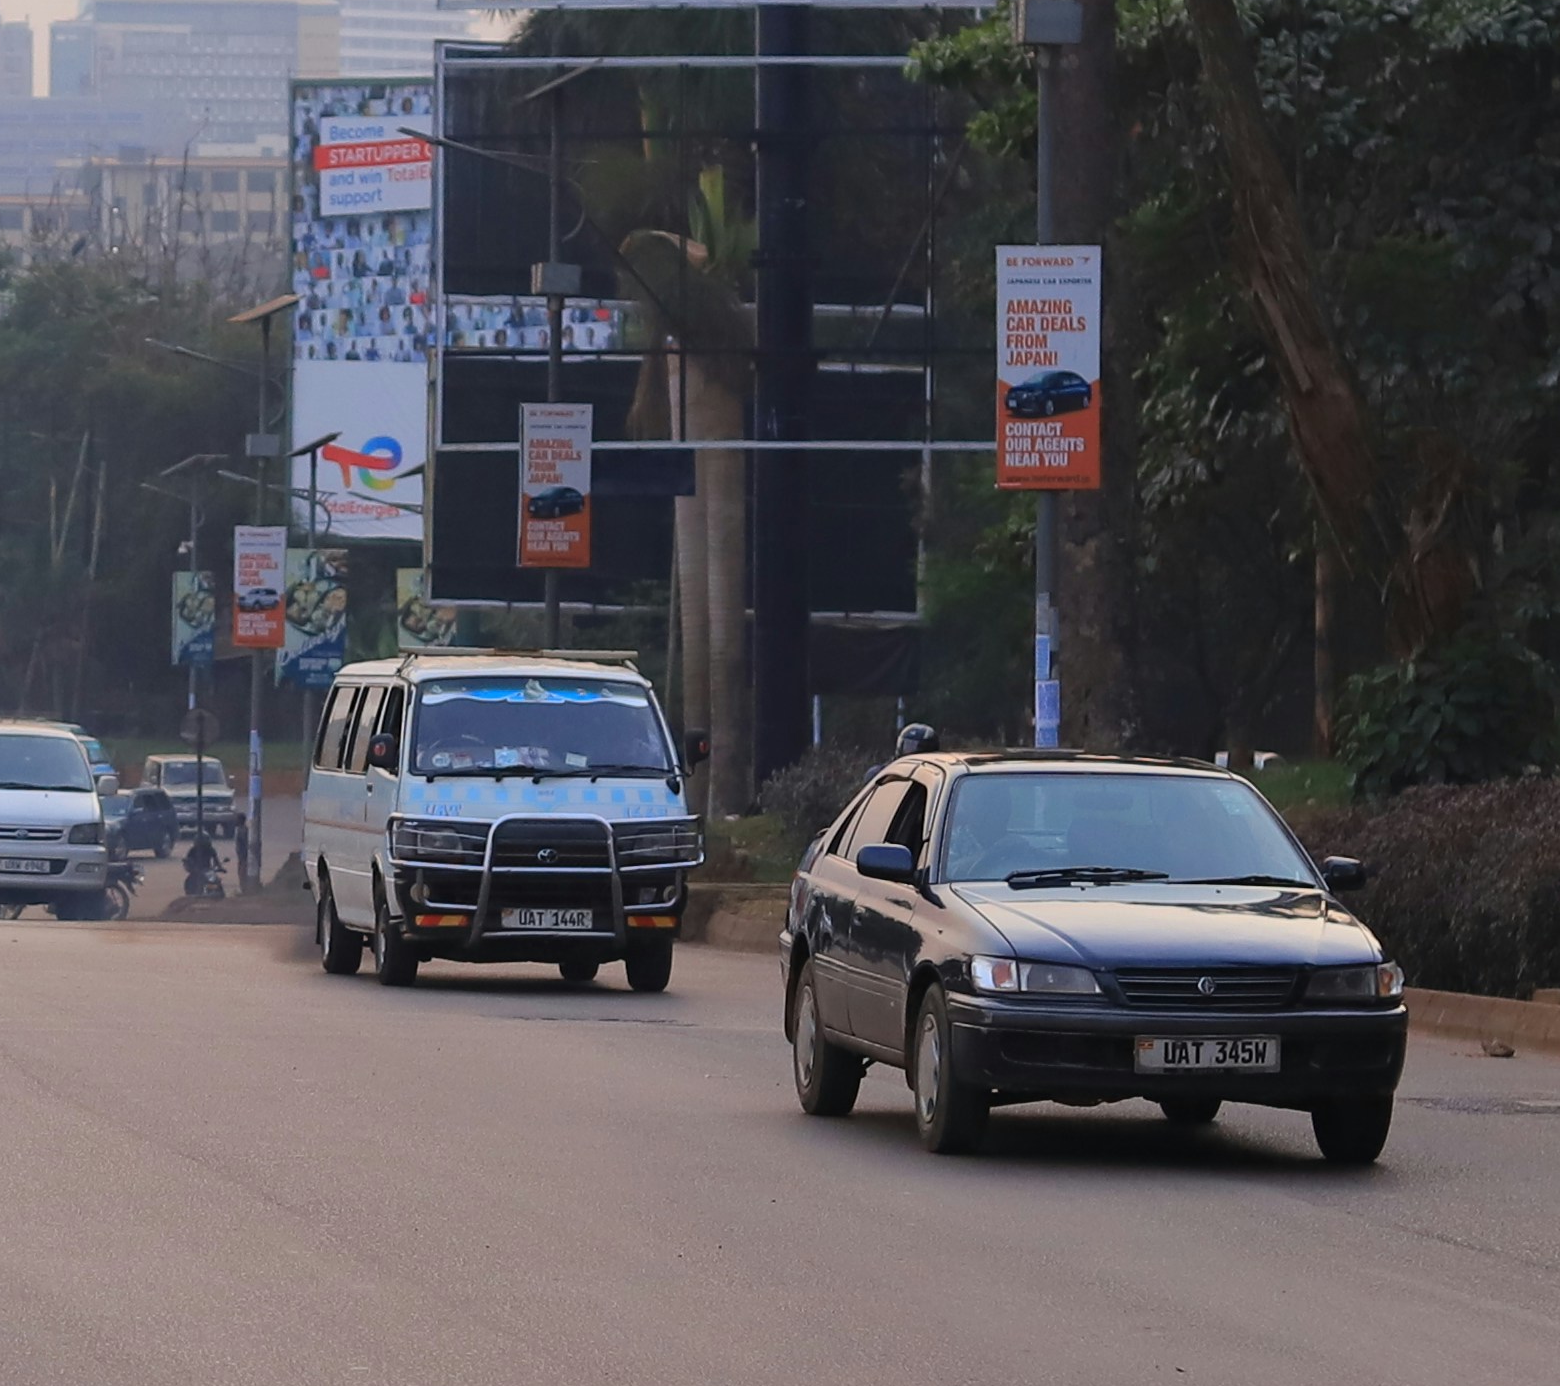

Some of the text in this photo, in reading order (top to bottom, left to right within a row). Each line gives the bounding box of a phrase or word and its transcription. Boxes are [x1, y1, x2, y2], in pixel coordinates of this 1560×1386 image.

[329, 125, 384, 141] Become
[329, 143, 421, 165] STARTUPPER
[329, 171, 354, 186] and
[360, 171, 383, 184] win
[329, 188, 383, 207] support
[1006, 257, 1074, 268] BE FORWARD
[1006, 299, 1072, 315] AMAZING
[1006, 316, 1086, 332] CAR DEALS
[1006, 333, 1048, 349] FROM
[1006, 351, 1058, 367] JAPAN!
[1005, 422, 1063, 437] CONTACT
[1005, 437, 1085, 452] OUR AGENTS
[1005, 453, 1068, 467] NEAR YOU
[518, 911, 587, 927] UAT 144R
[1163, 1041, 1267, 1064] UAT 345W
